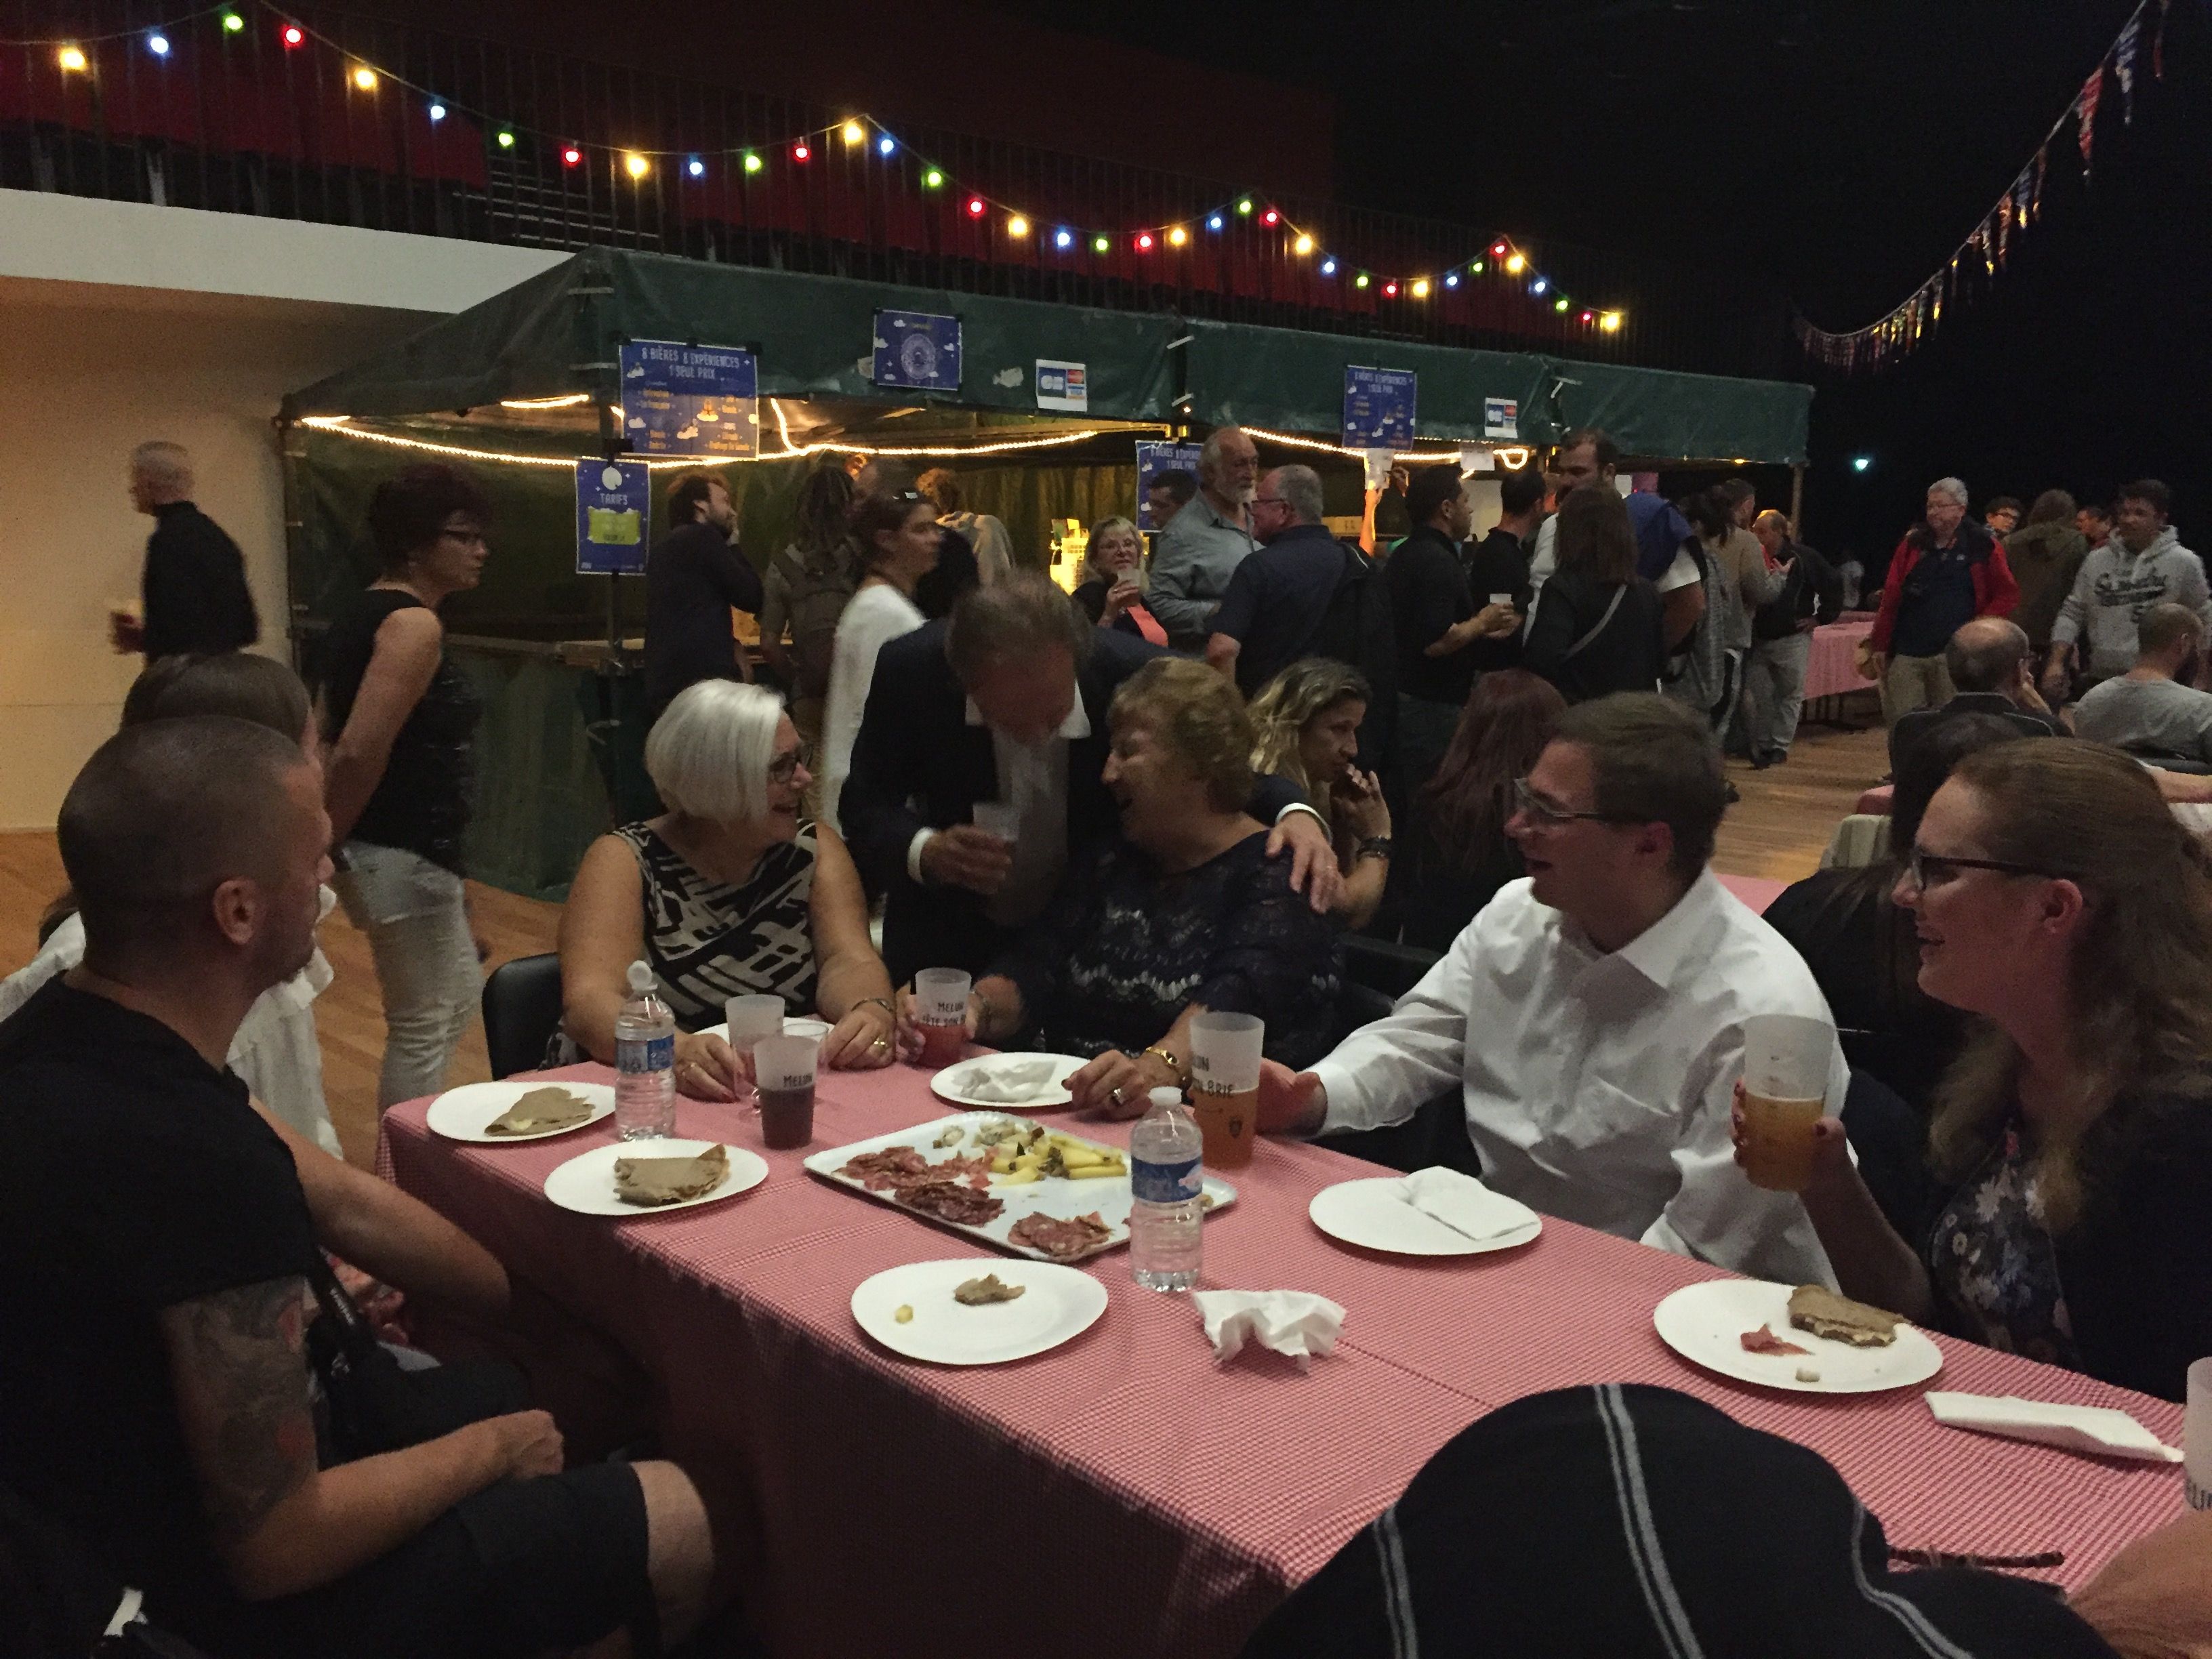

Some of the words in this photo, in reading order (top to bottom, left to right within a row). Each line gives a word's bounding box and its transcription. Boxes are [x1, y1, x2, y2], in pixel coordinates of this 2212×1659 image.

[650, 345, 678, 361] BIÈRES
[691, 352, 739, 369] EXPÉRIENCES
[697, 368, 716, 380] PRIX
[600, 493, 628, 506] TARIFS
[938, 1002, 964, 1012] MELUN
[783, 1072, 813, 1087] MELUN
[1208, 1080, 1234, 1099] BRIE
